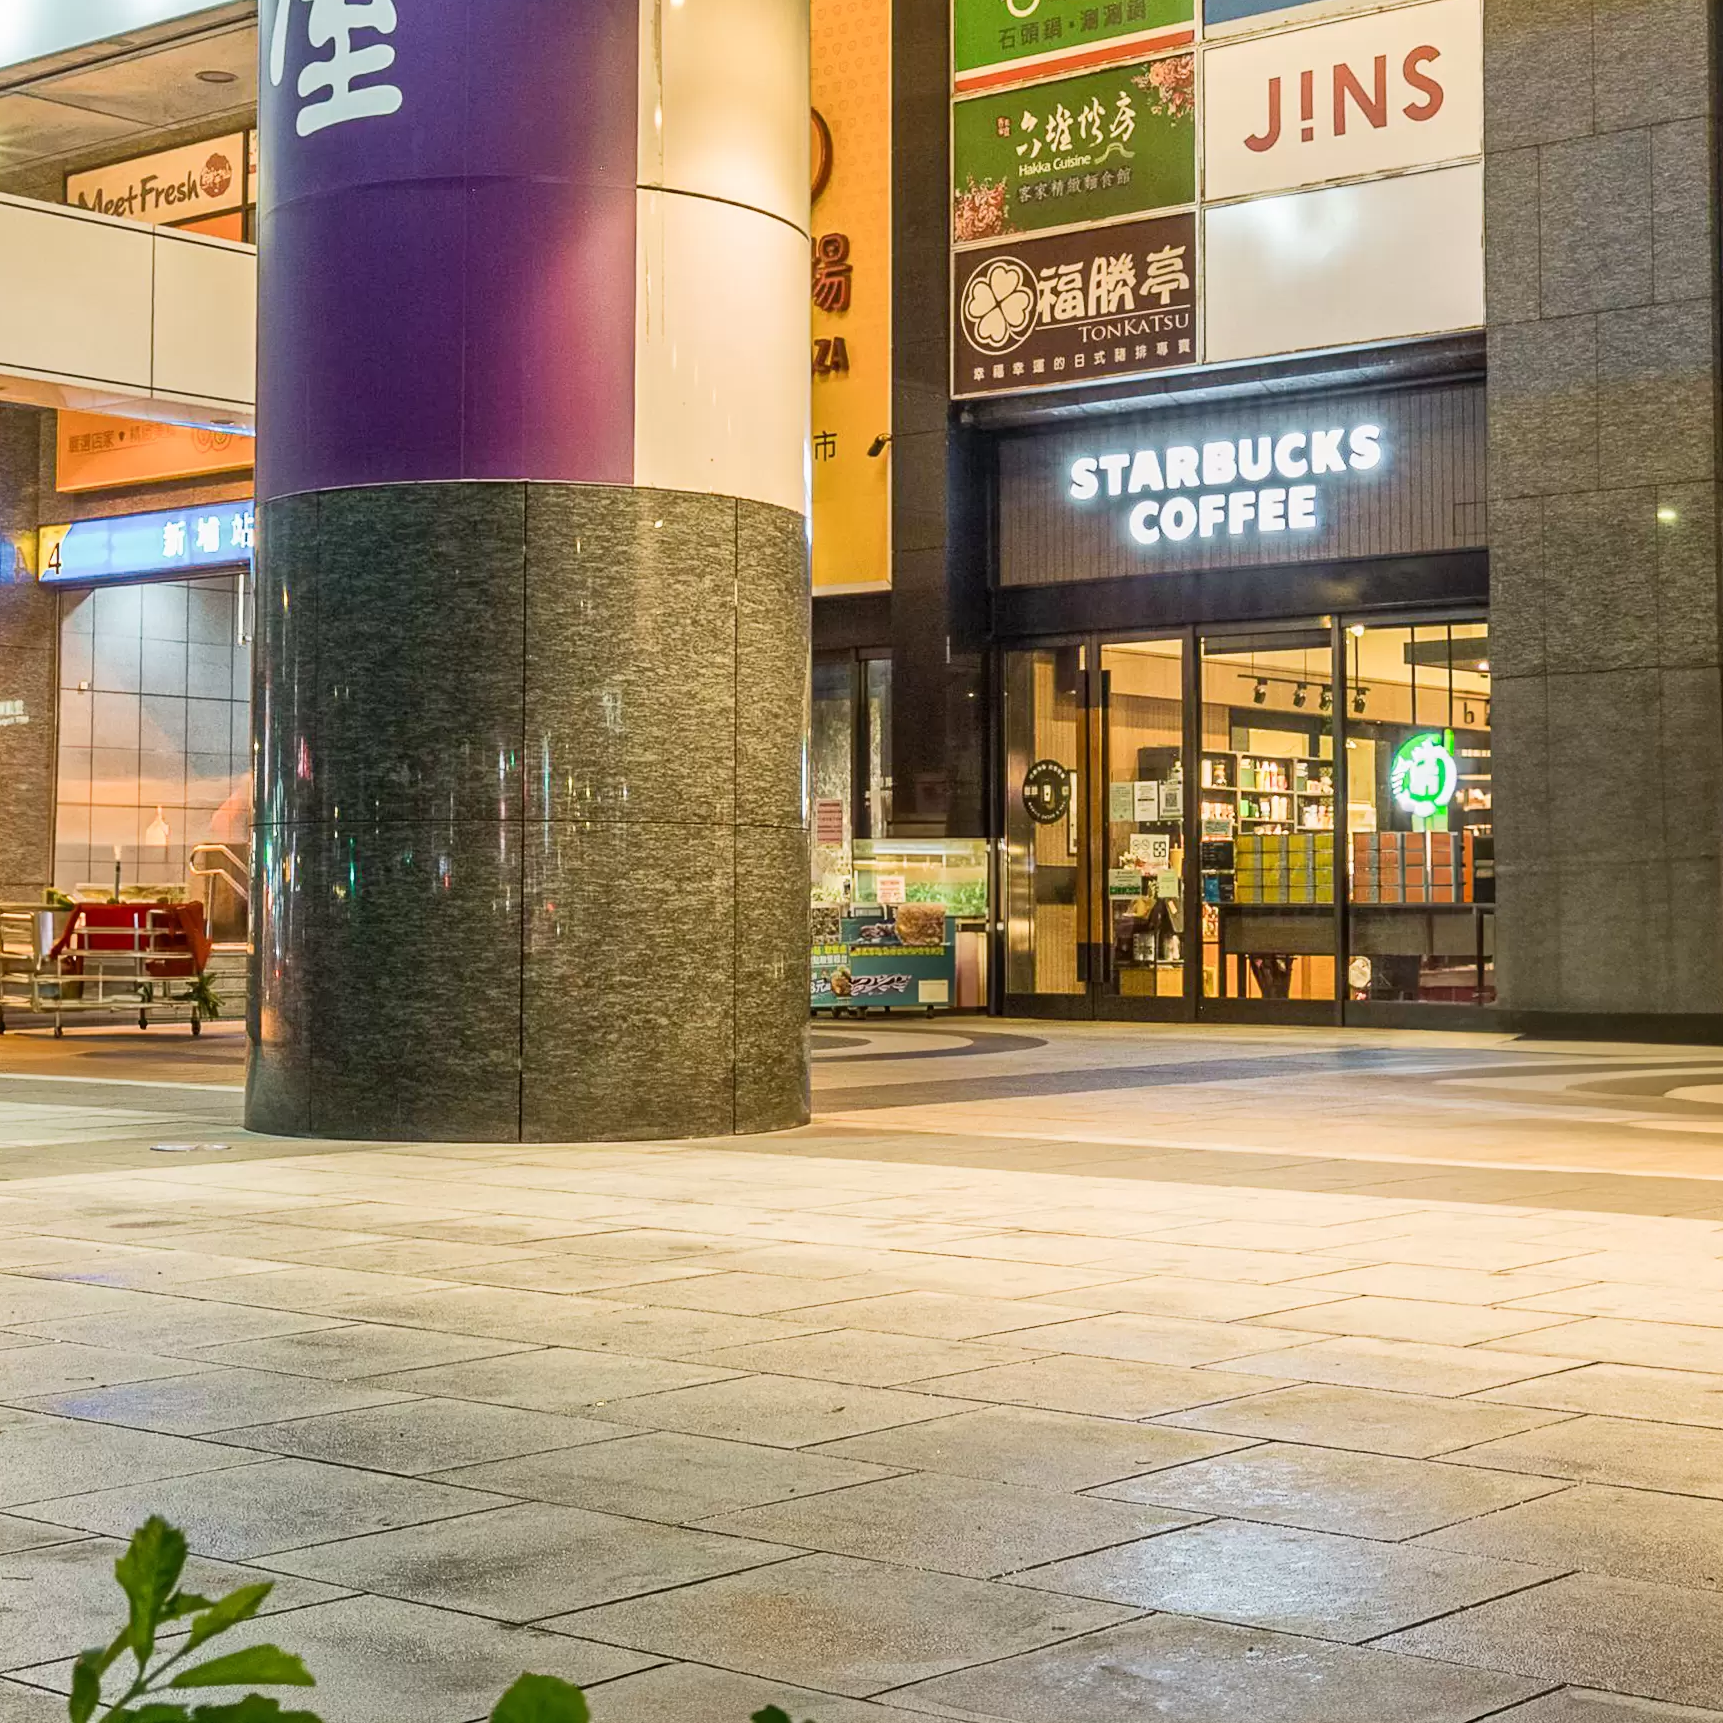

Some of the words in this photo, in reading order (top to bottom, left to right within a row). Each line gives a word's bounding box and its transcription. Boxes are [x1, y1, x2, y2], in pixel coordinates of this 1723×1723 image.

[1018, 163, 1052, 177] Hakka
[1053, 154, 1092, 171] Cuisine
[1034, 243, 1192, 324] 福勝亭
[1078, 313, 1190, 343] TONKATSU
[813, 430, 838, 462] 市
[1068, 424, 1382, 501] STARBUCKS
[1128, 484, 1318, 545] COFFEE
[47, 542, 62, 575] 4
